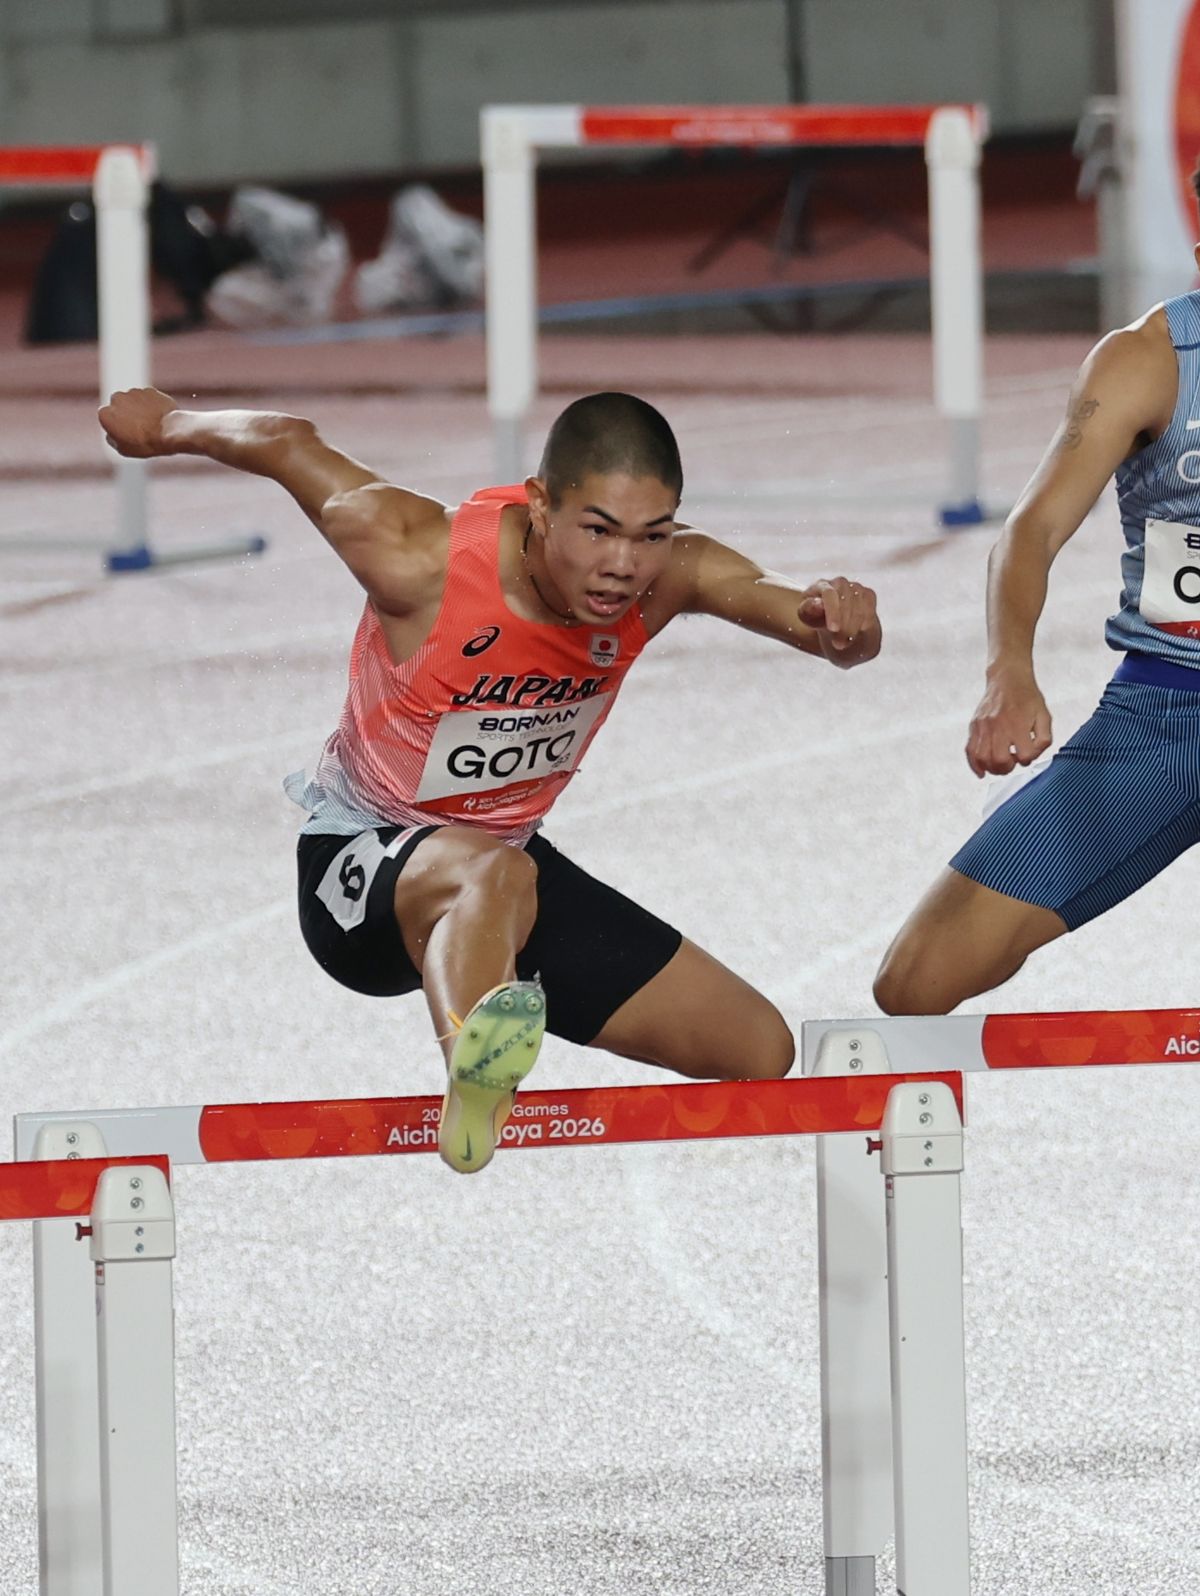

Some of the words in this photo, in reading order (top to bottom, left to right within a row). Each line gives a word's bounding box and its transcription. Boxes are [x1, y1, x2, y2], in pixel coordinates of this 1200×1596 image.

[450, 674, 609, 706] JAPAN
[478, 707, 580, 733] BORNAN
[447, 729, 576, 779] GOTO
[338, 853, 366, 903] 6
[421, 1108, 441, 1122] 20
[511, 1103, 569, 1118] Games
[548, 1117, 606, 1138] 2026
